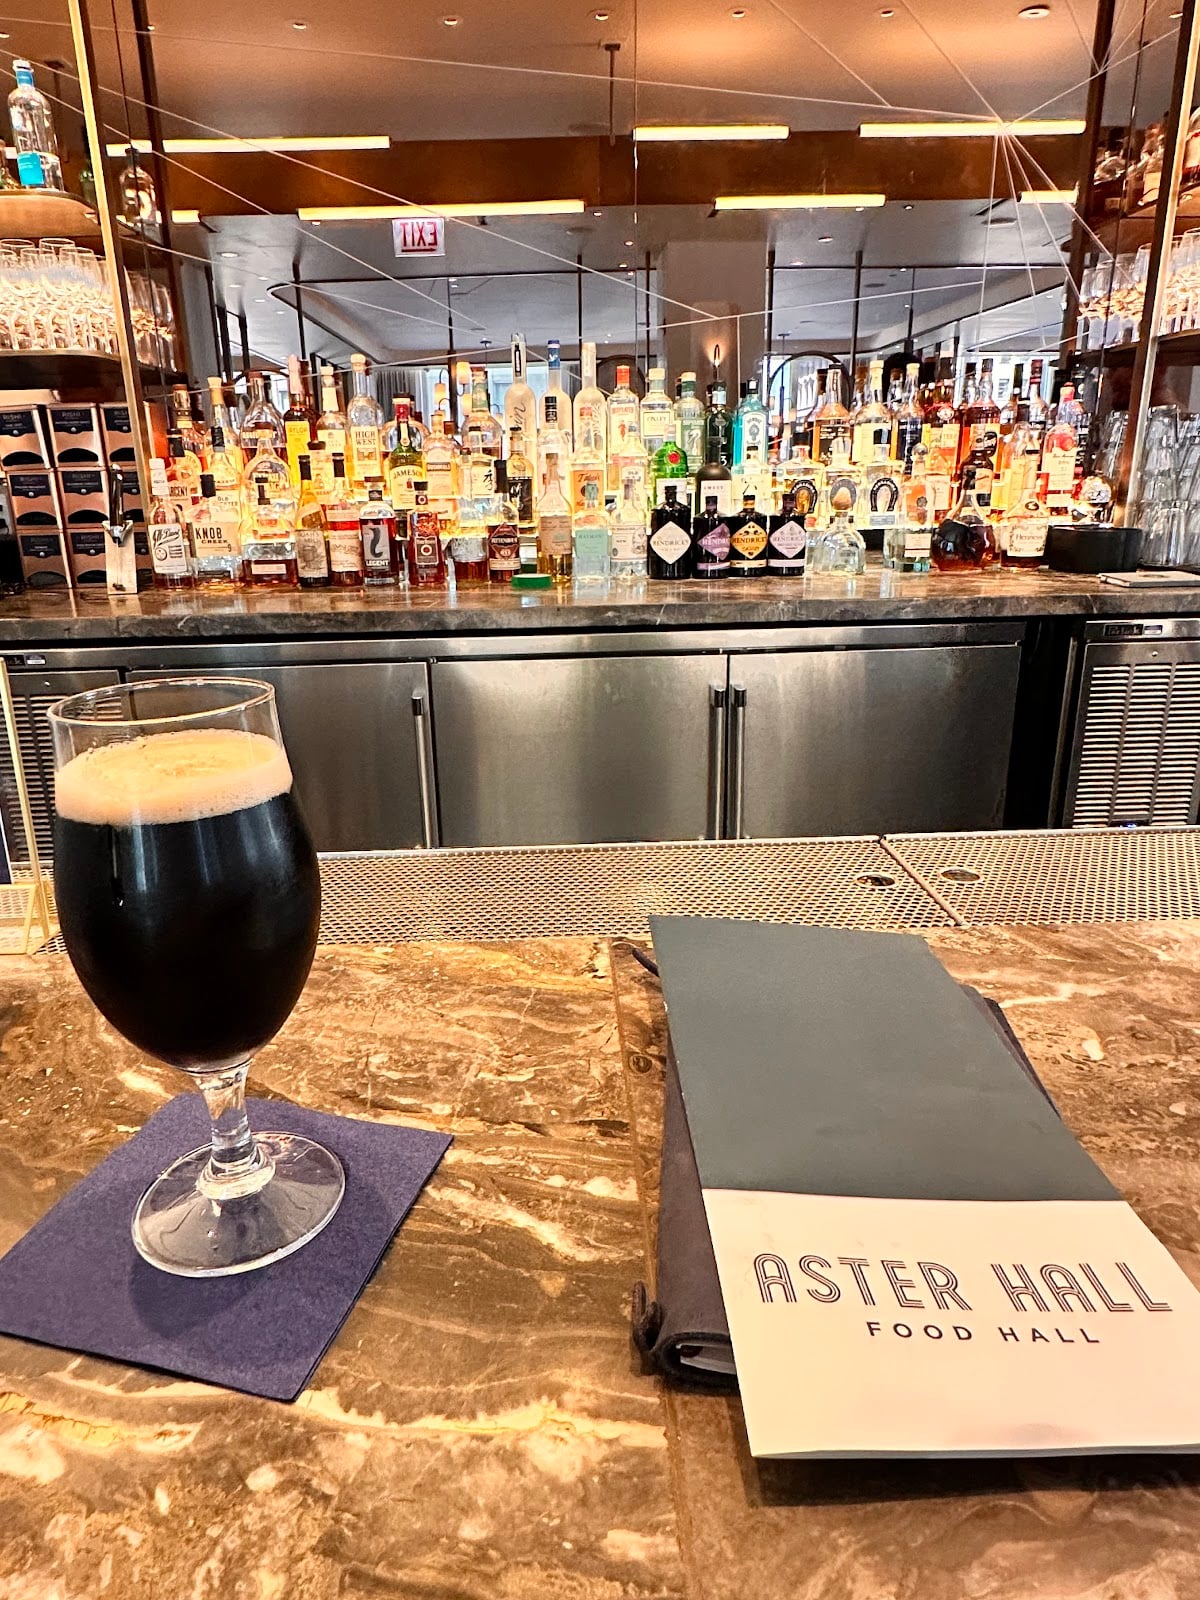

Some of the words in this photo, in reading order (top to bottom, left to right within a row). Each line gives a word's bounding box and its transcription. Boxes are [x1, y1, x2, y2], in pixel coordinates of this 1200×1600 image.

[355, 430, 376, 439] HIGH
[195, 527, 223, 540] KNOB
[365, 559, 389, 567] LEGENT
[754, 1253, 973, 1311] ASTER
[990, 1262, 1173, 1312] HALL
[866, 1321, 973, 1341] FOOD
[997, 1326, 1101, 1343] HALL
